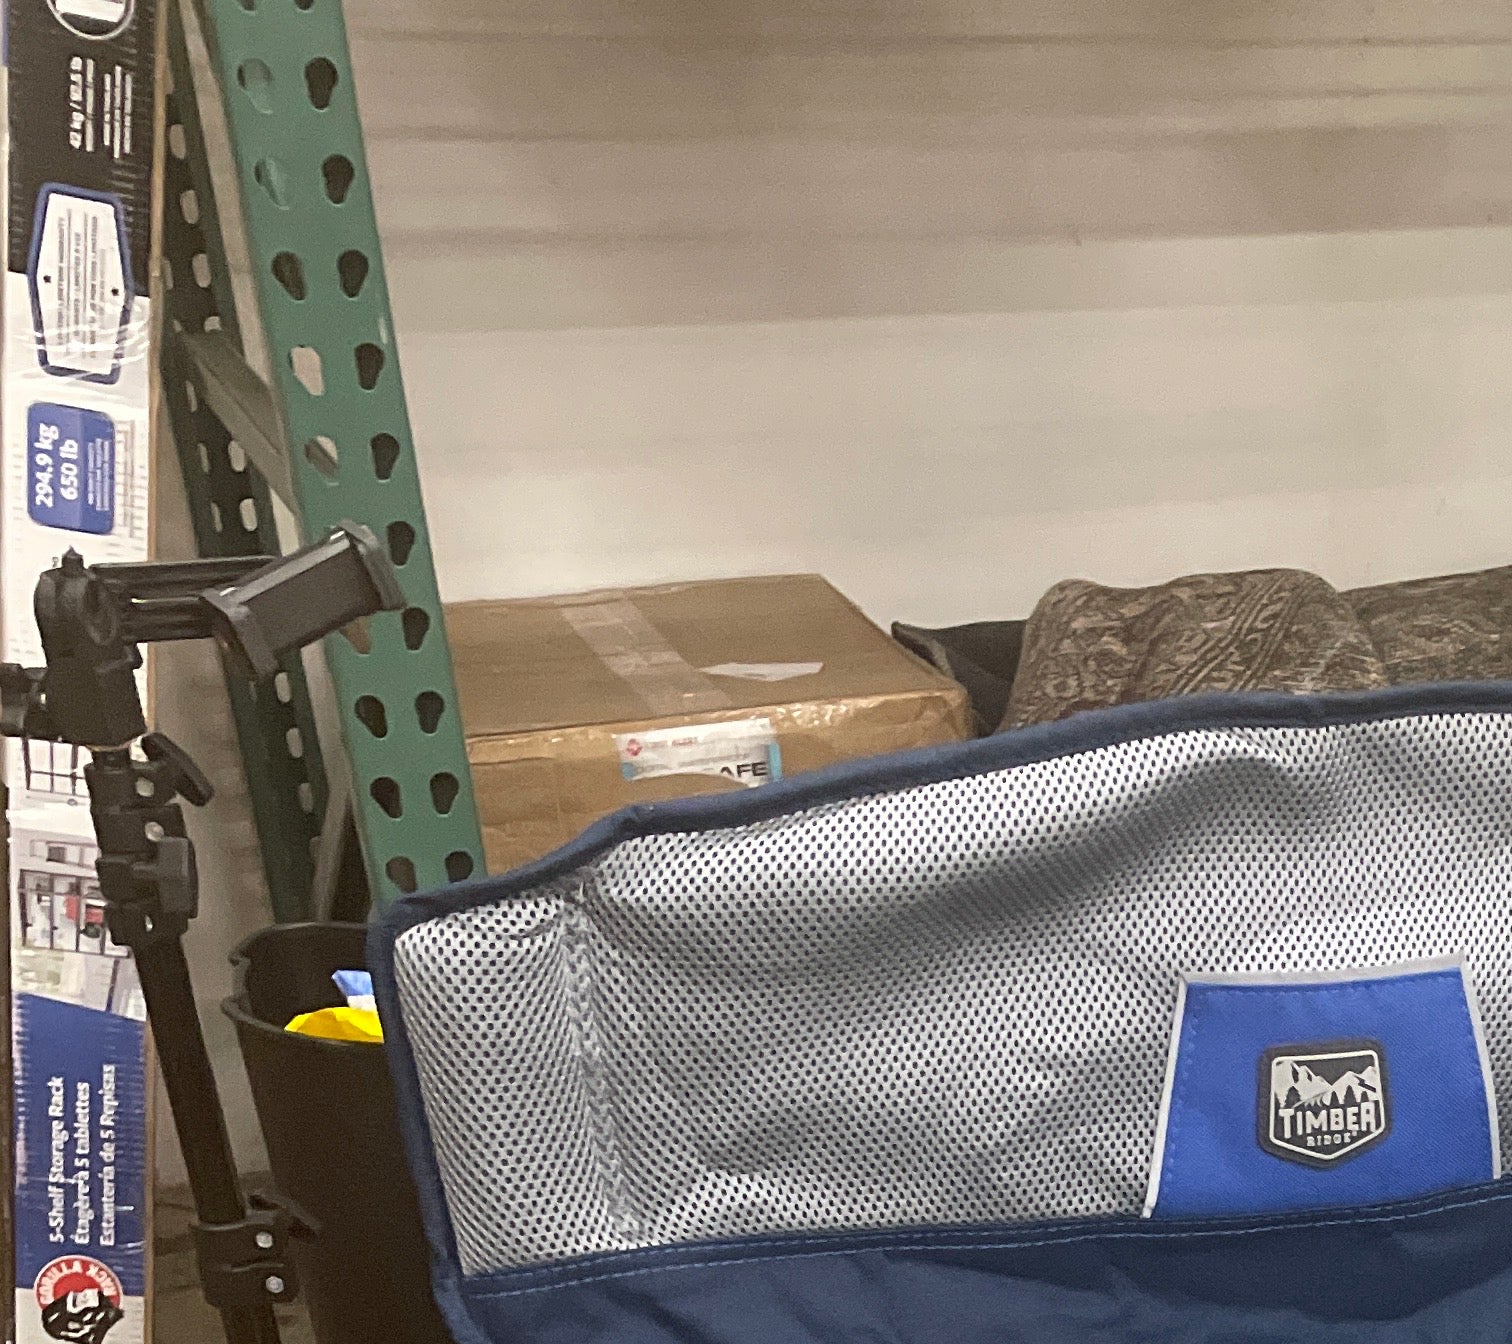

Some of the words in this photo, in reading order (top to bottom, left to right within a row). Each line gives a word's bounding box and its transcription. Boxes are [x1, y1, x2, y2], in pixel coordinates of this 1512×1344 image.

[34, 422, 59, 451] kg
[59, 439, 79, 460] lb
[34, 453, 54, 508] 294.9
[60, 462, 79, 501] 650
[48, 1076, 64, 1117] Rack
[98, 1064, 119, 1126] Repisas
[73, 1082, 90, 1155] tablettes
[100, 1129, 115, 1139] 5
[1278, 1101, 1377, 1139] TIMBER
[49, 1120, 69, 1183] Storage
[74, 1157, 89, 1168] 5
[99, 1142, 115, 1163] de
[48, 1185, 65, 1243] 5-Shelf
[98, 1166, 115, 1246] Estantería
[39, 1260, 83, 1305] GORILLA
[85, 1263, 118, 1297] RACK
